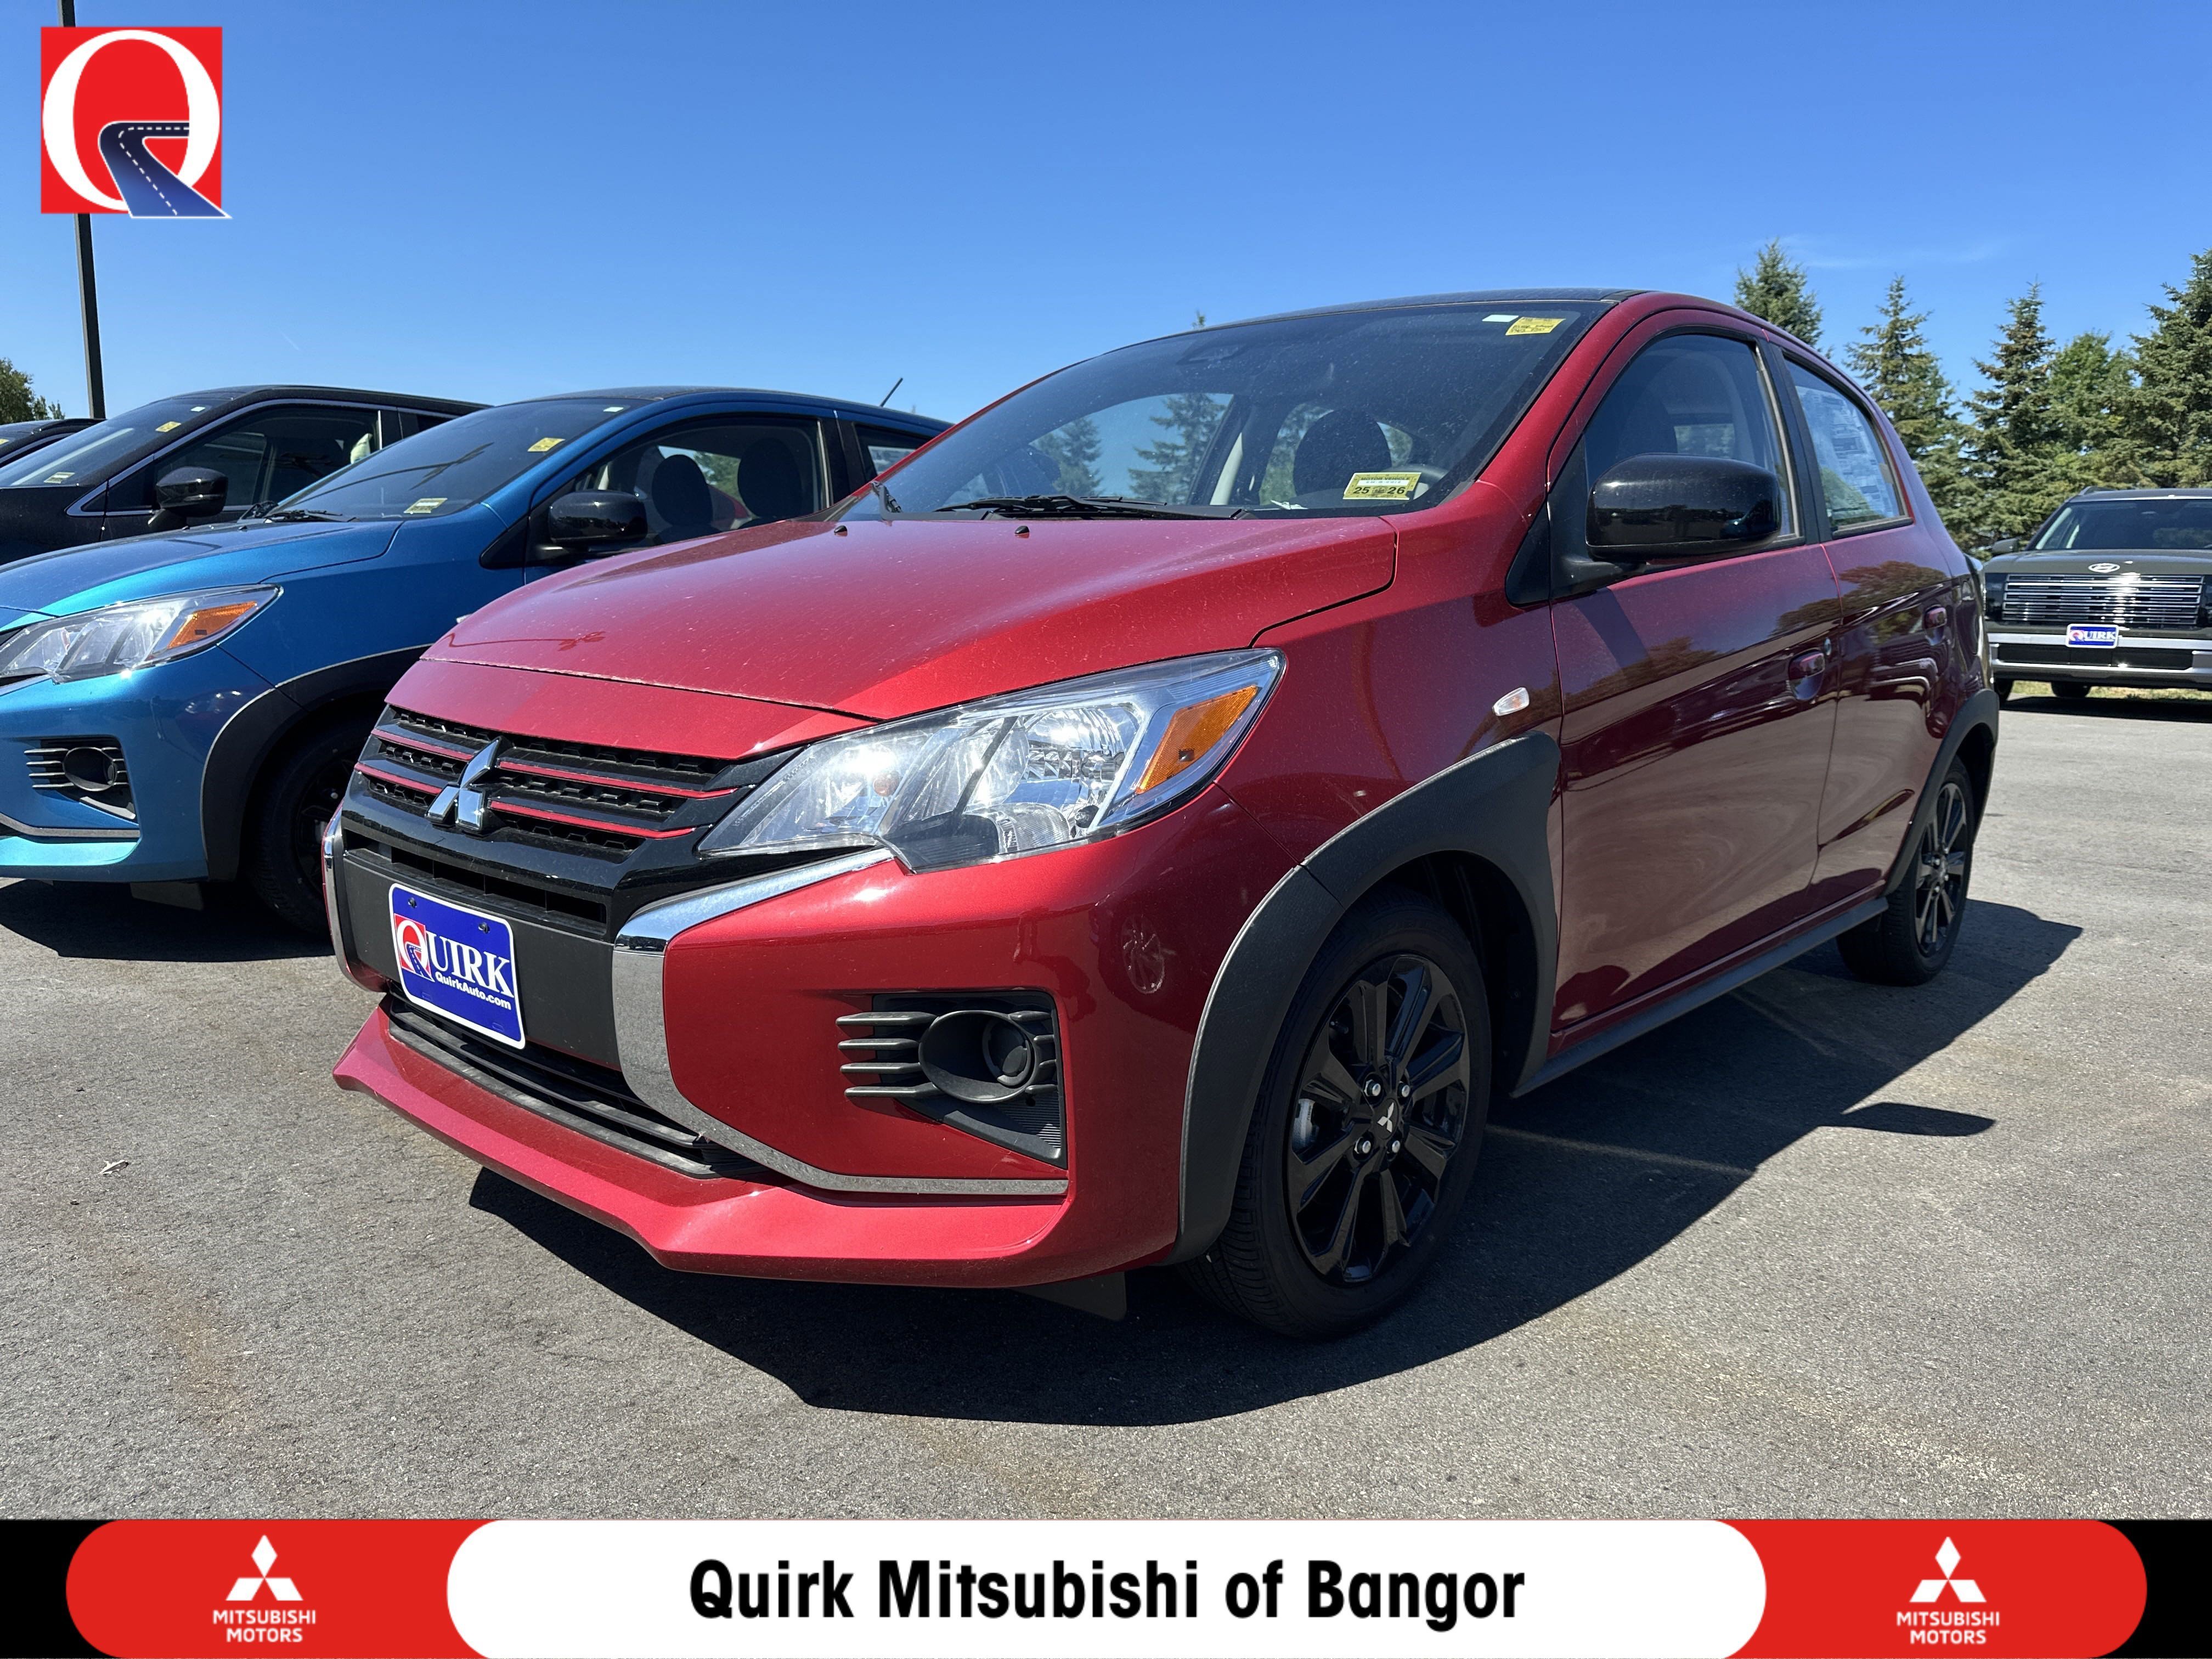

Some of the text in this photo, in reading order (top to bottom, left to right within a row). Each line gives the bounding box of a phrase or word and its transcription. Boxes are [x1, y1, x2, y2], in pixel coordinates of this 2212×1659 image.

[2069, 630, 2116, 641] QUIRK
[396, 919, 515, 998] QUIRK
[435, 971, 511, 1010] QuirkAuto.com
